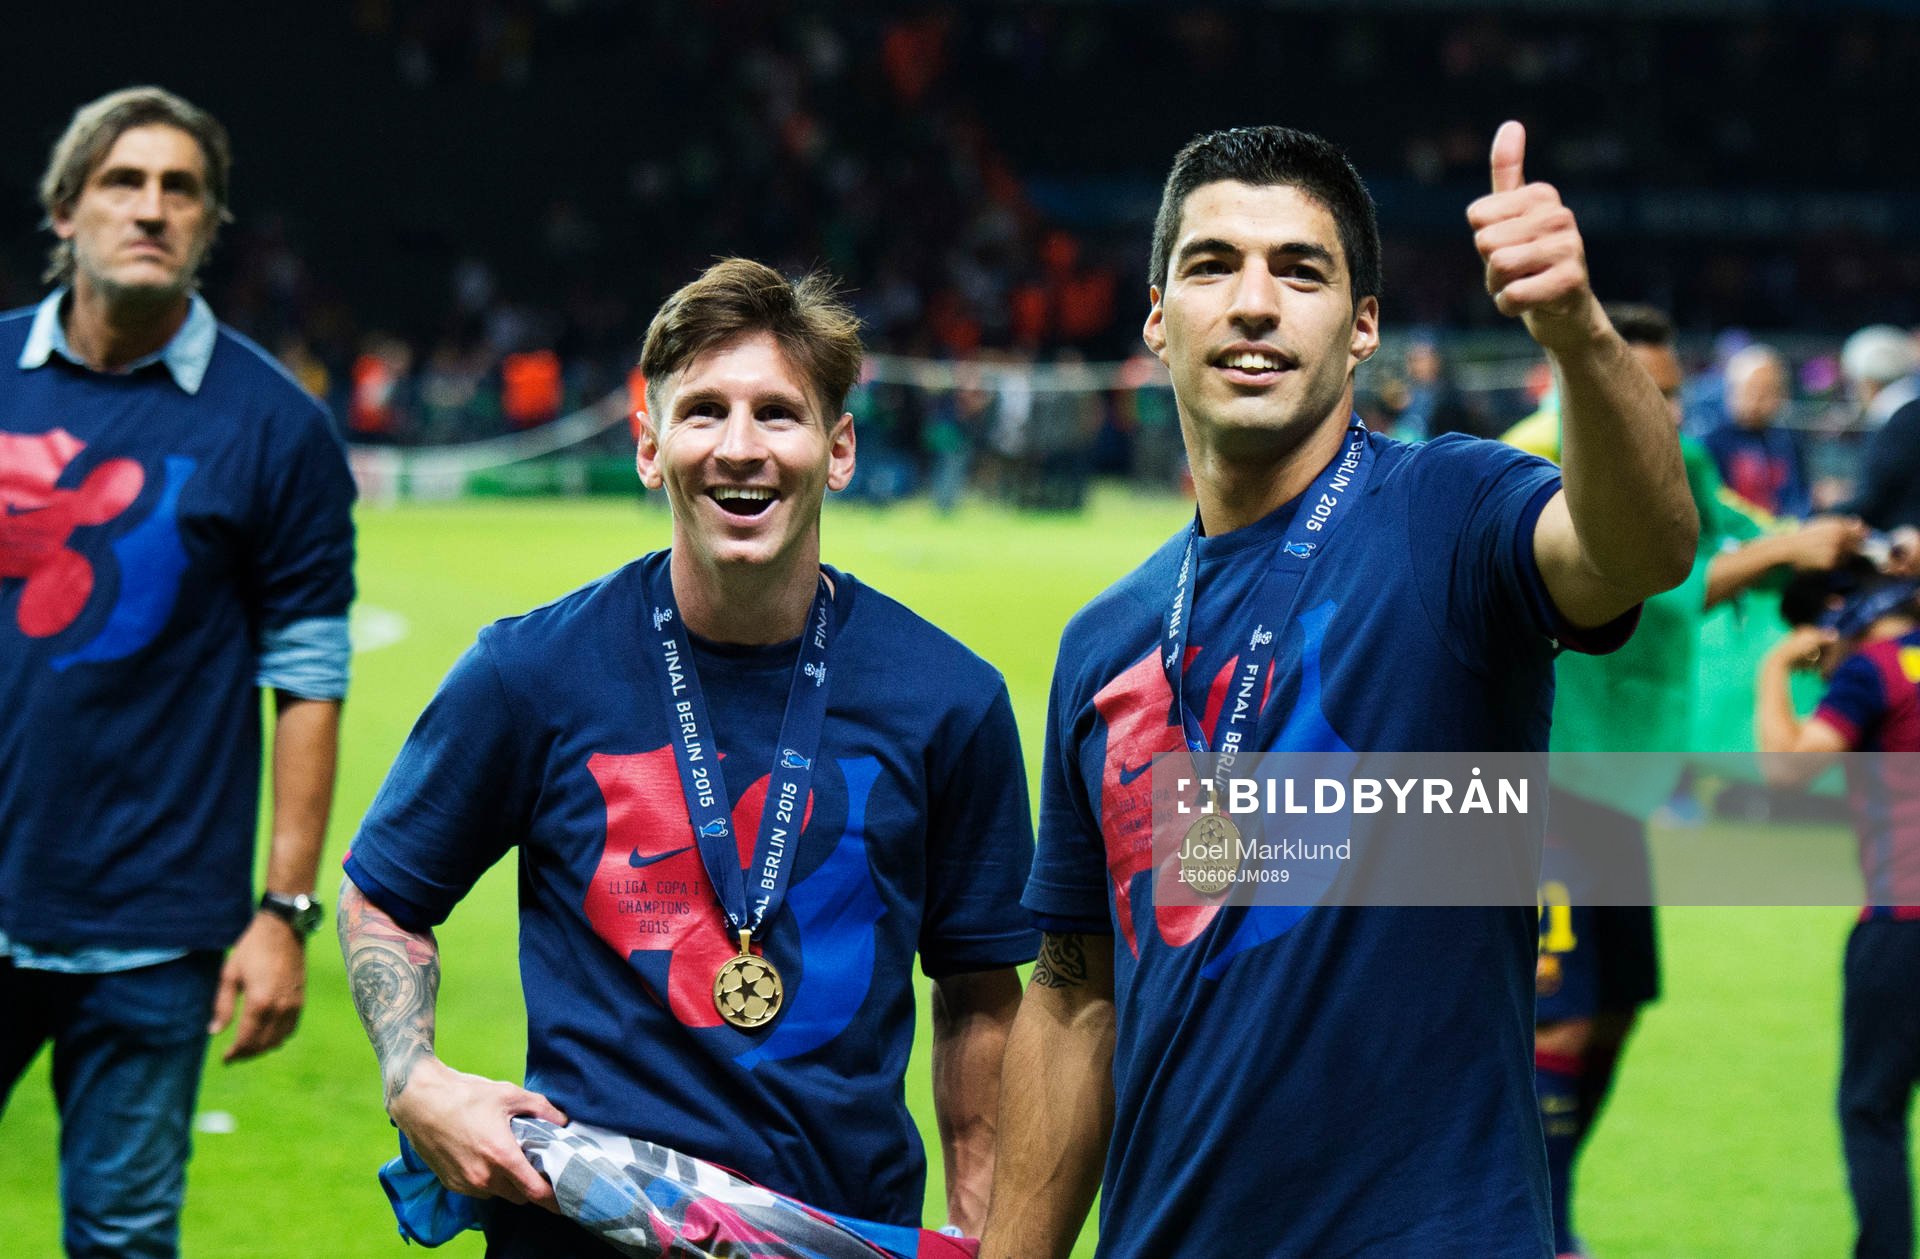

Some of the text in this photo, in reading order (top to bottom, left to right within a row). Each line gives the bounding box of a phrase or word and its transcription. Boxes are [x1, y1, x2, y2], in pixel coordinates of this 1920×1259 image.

[1329, 441, 1364, 493] BERLIN
[1305, 493, 1338, 532] 2015
[1168, 587, 1185, 640] FINAL
[1230, 664, 1259, 724] FINAL
[662, 639, 715, 808] FINAL BERLIN 2015
[761, 828, 787, 890] BERLIN
[776, 782, 798, 824] 2015
[609, 880, 648, 895] LLIGA
[656, 881, 688, 896] COPA
[618, 900, 690, 915] CHAMPIONS
[639, 920, 670, 934] 2015
